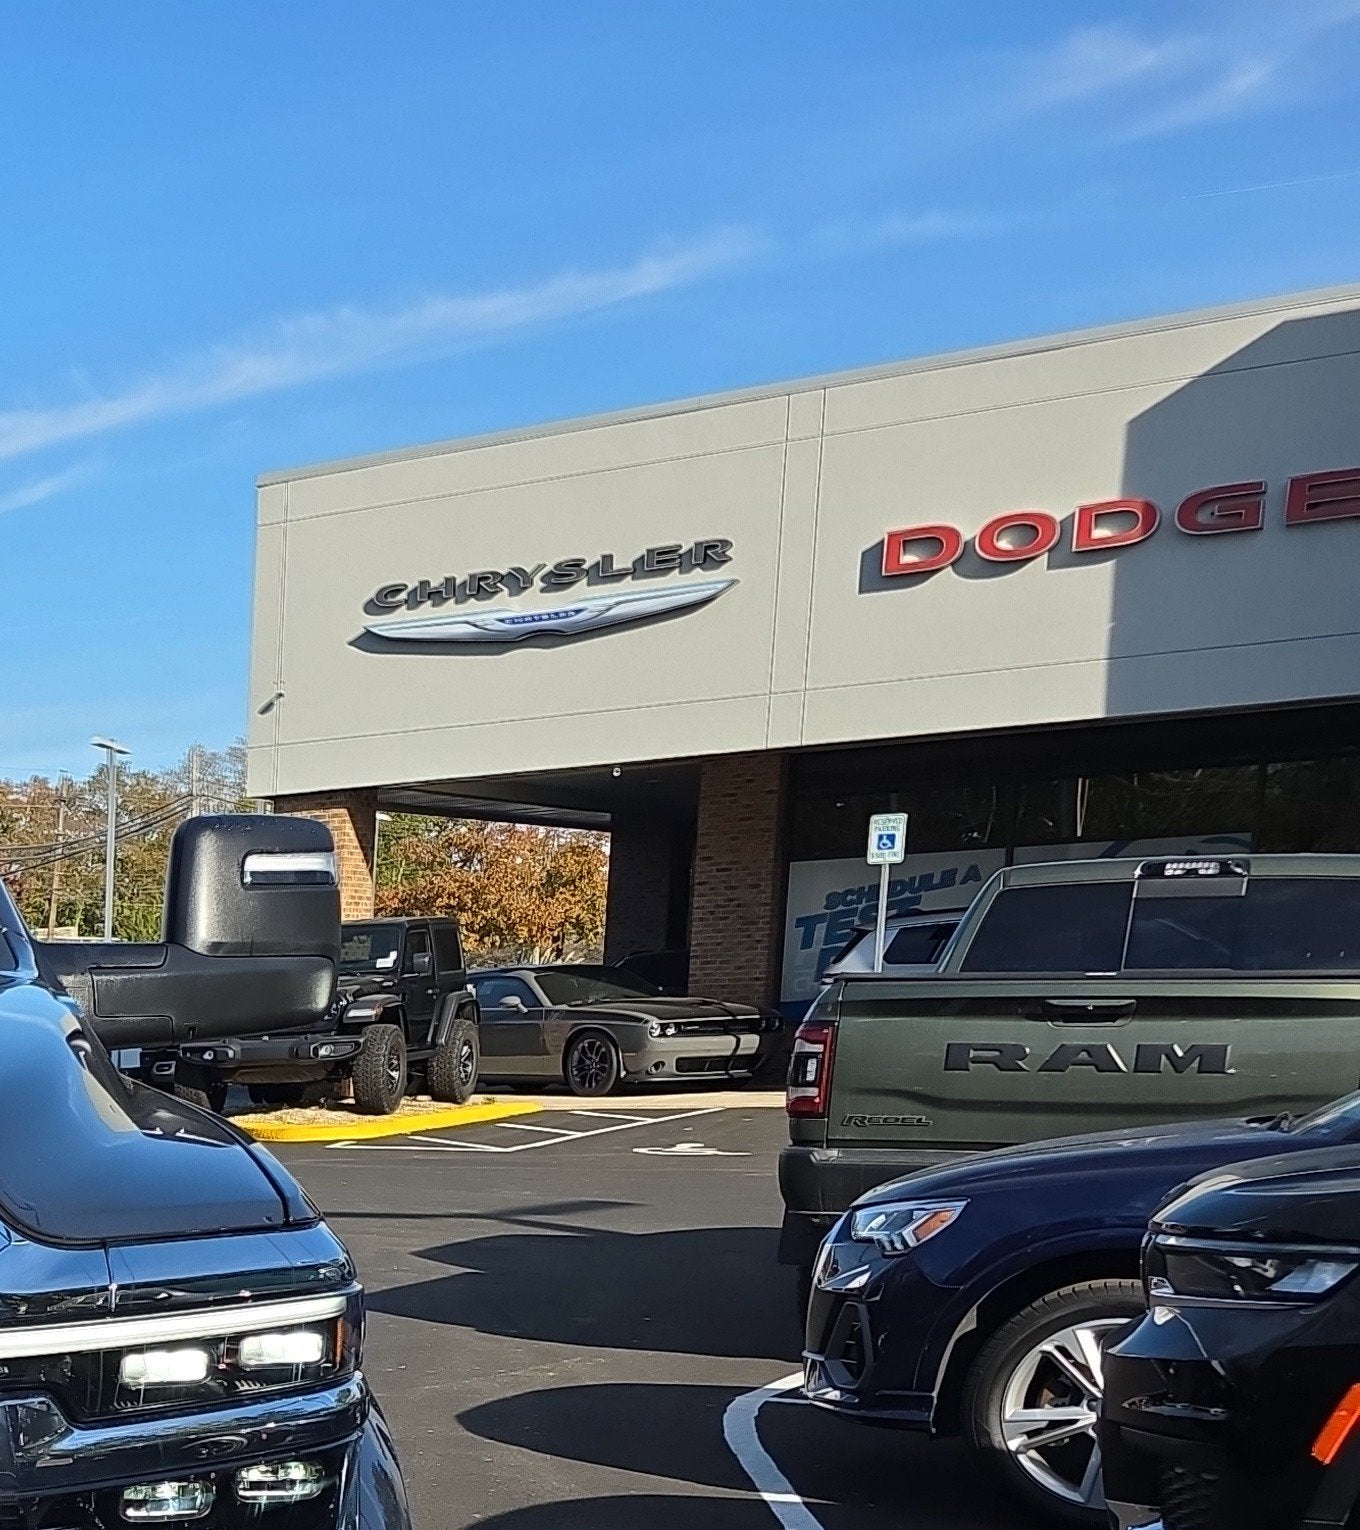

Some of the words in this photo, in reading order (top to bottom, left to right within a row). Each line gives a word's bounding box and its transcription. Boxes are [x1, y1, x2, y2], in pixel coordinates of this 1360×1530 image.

[882, 467, 1360, 577] DODGE
[372, 538, 735, 607] CHRYSLER
[823, 867, 958, 911] SCHDULE
[960, 863, 982, 885] A
[942, 1042, 1232, 1074] RAM
